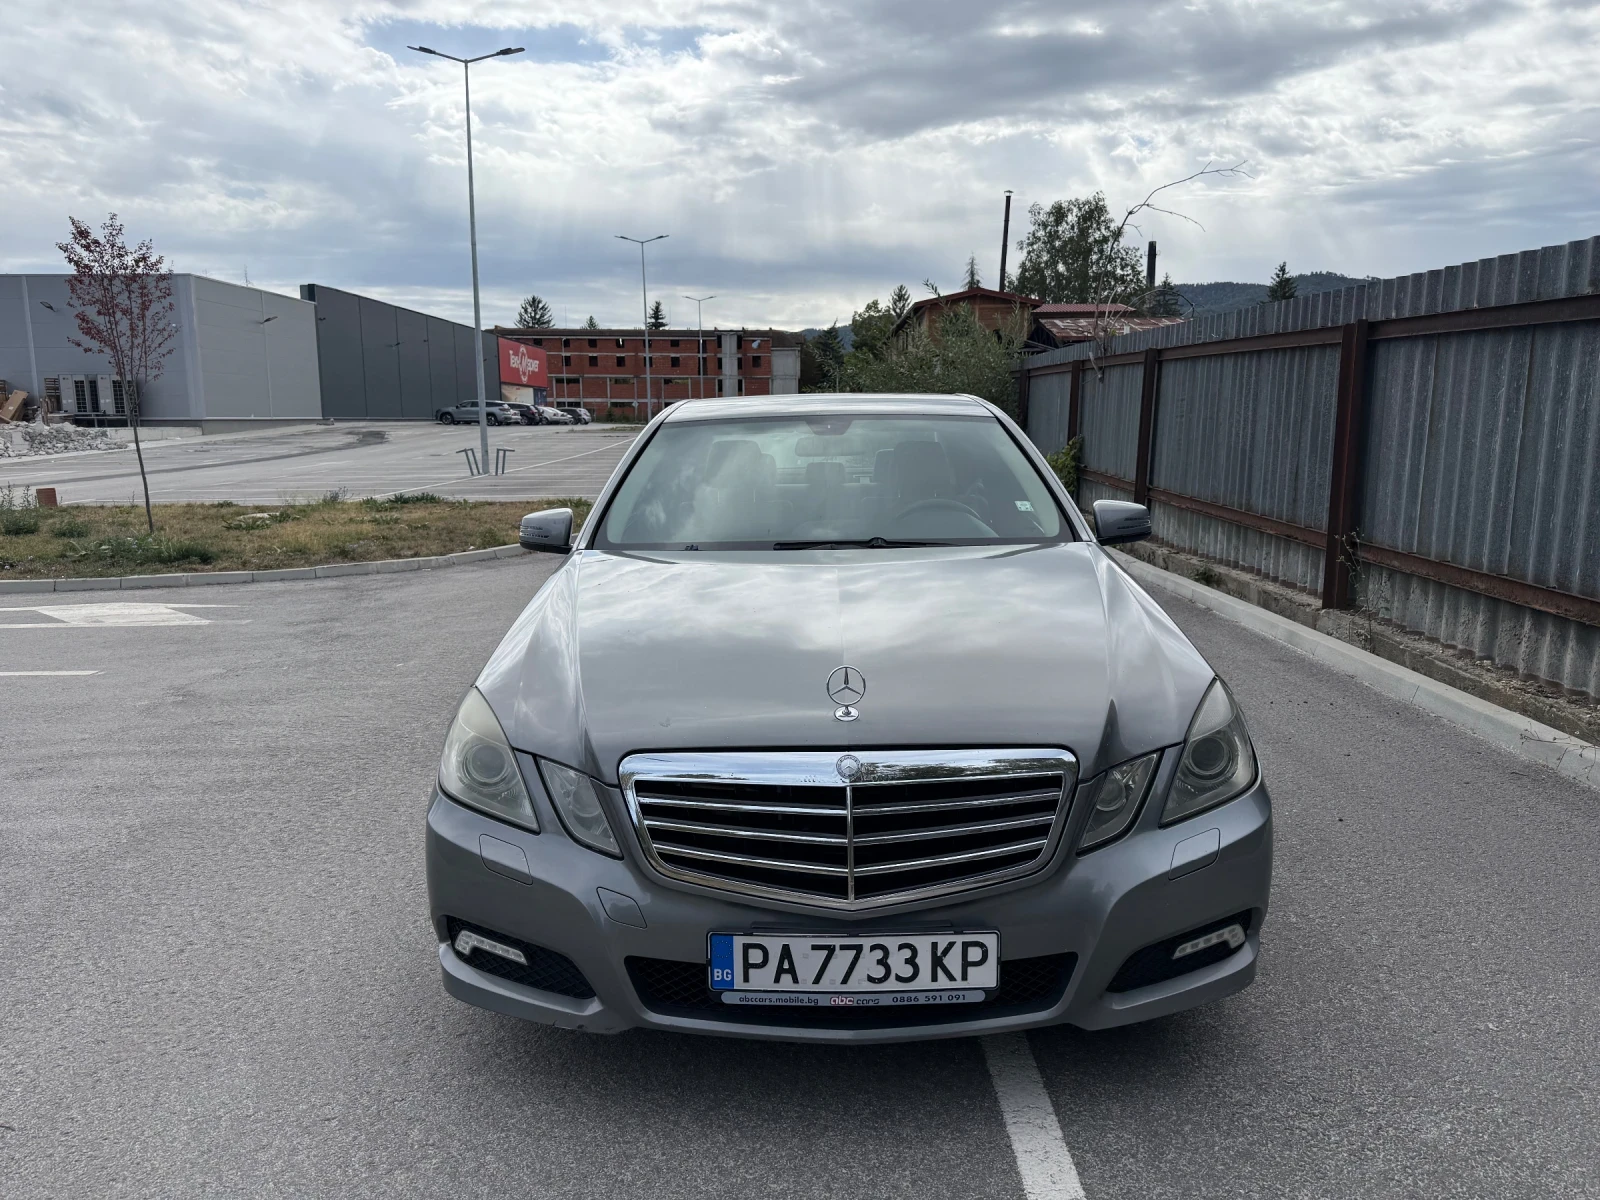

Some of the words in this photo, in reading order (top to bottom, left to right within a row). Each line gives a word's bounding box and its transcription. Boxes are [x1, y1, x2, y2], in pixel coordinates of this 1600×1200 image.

[713, 968, 732, 981] BG
[738, 995, 819, 1005] abccars.mobile.bg
[829, 995, 854, 1005] abc
